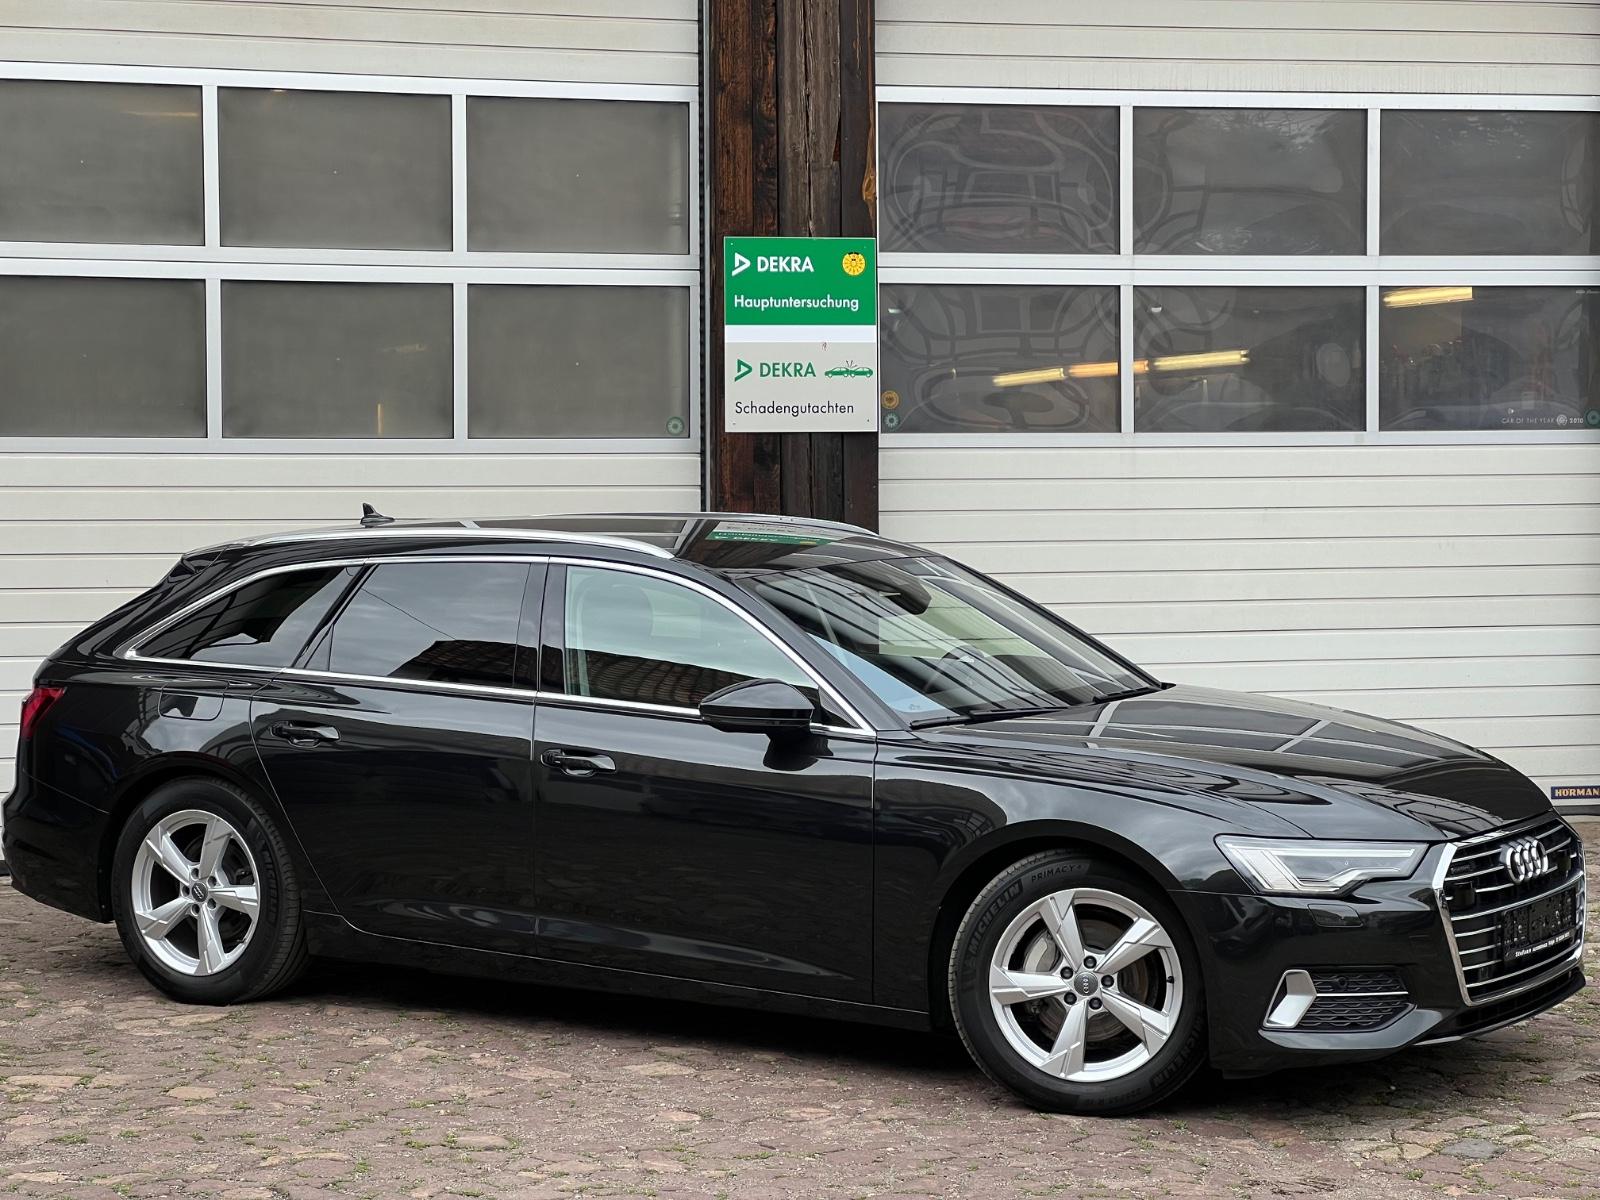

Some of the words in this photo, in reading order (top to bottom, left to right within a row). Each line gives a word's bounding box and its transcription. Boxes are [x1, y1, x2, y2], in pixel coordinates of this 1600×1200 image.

[757, 256, 815, 273] DEKRA
[734, 294, 859, 312] Hauptuntersuchung
[759, 362, 816, 378] DEKRA
[735, 400, 854, 418] Schadengutachten
[967, 881, 1021, 955] MICHELIN
